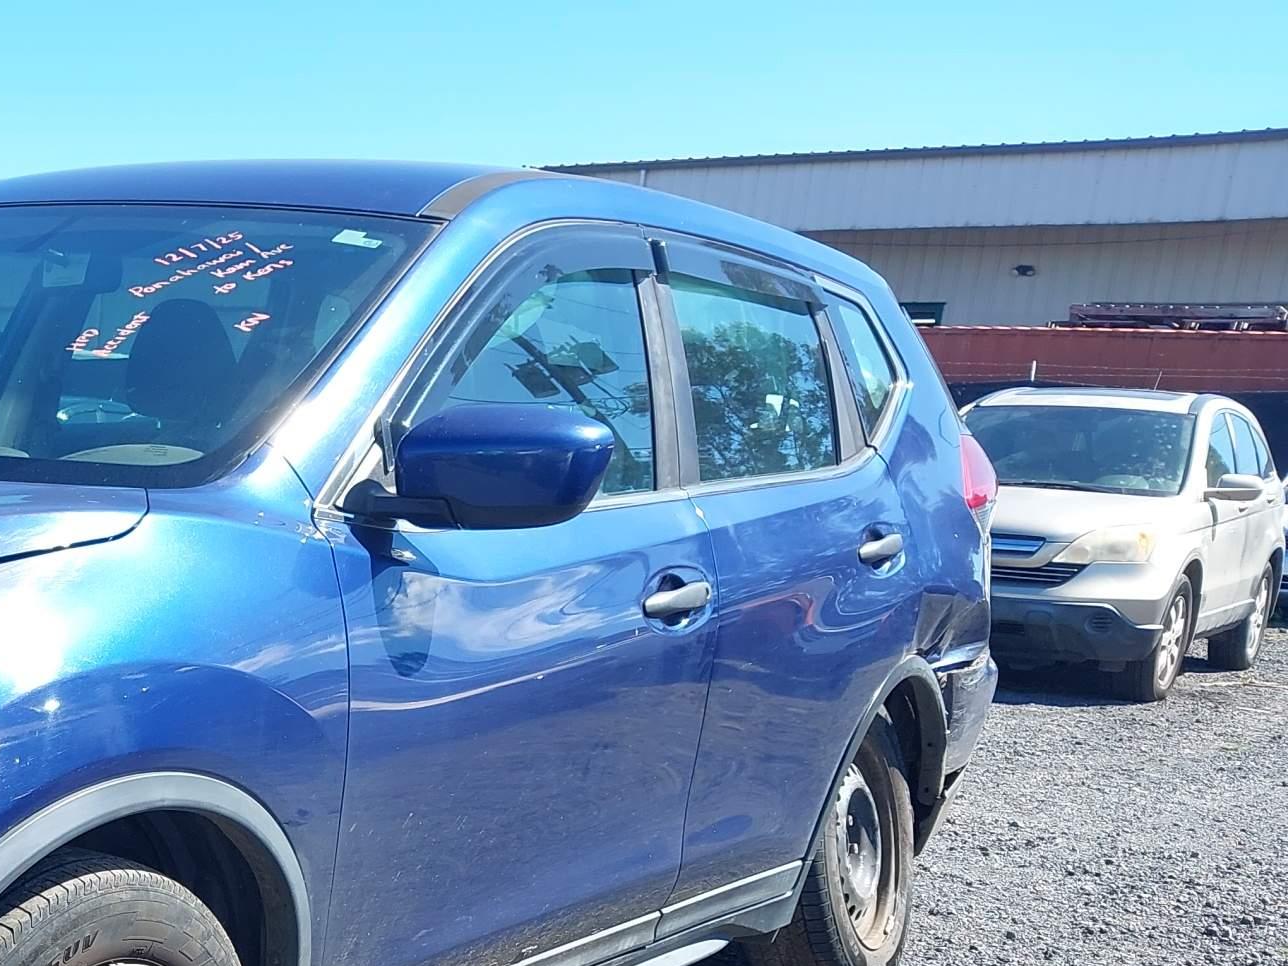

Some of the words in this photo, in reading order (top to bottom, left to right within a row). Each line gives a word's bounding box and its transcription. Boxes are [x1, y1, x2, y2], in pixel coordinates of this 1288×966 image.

[154, 231, 243, 266] 12/7/25
[210, 259, 256, 278] Kam
[259, 243, 294, 259] Ave
[213, 282, 237, 294] to
[65, 328, 99, 352] HPD
[91, 311, 151, 358] Accident
